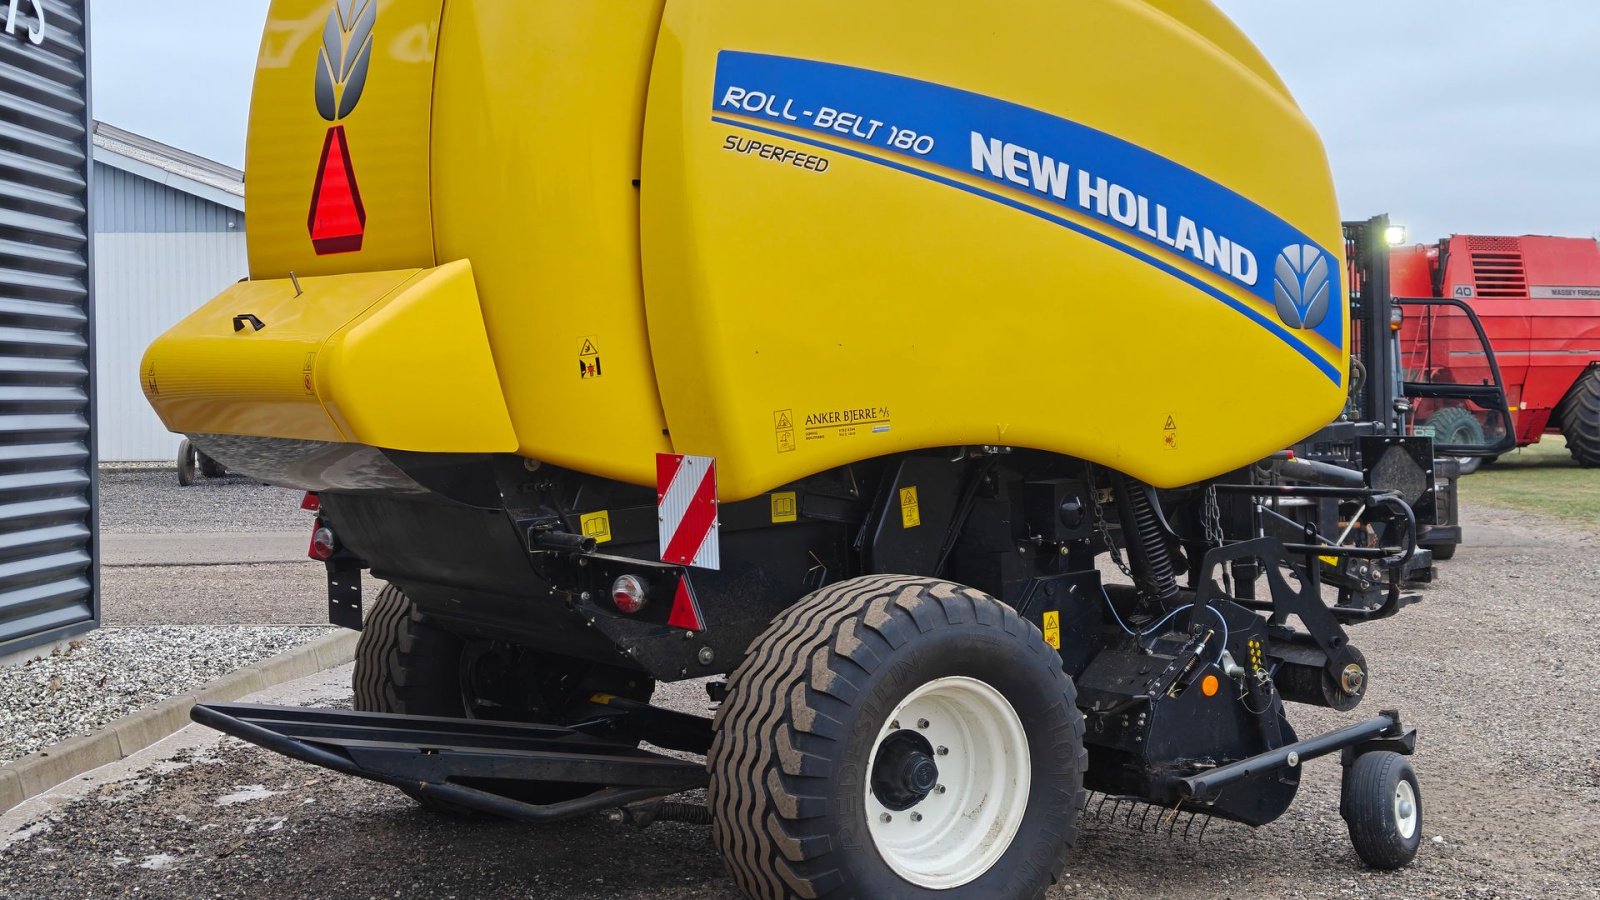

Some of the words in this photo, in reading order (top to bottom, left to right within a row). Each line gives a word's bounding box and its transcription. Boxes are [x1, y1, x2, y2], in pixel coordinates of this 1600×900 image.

[886, 125, 936, 156] 180
[722, 135, 830, 173] SUPERFEED
[970, 130, 1070, 200] NEW
[1078, 169, 1259, 287] HOLLAND
[1455, 286, 1472, 297] 40
[1551, 289, 1576, 297] MASSEY
[805, 412, 841, 425] ANKER
[844, 408, 877, 423] BJERRE
